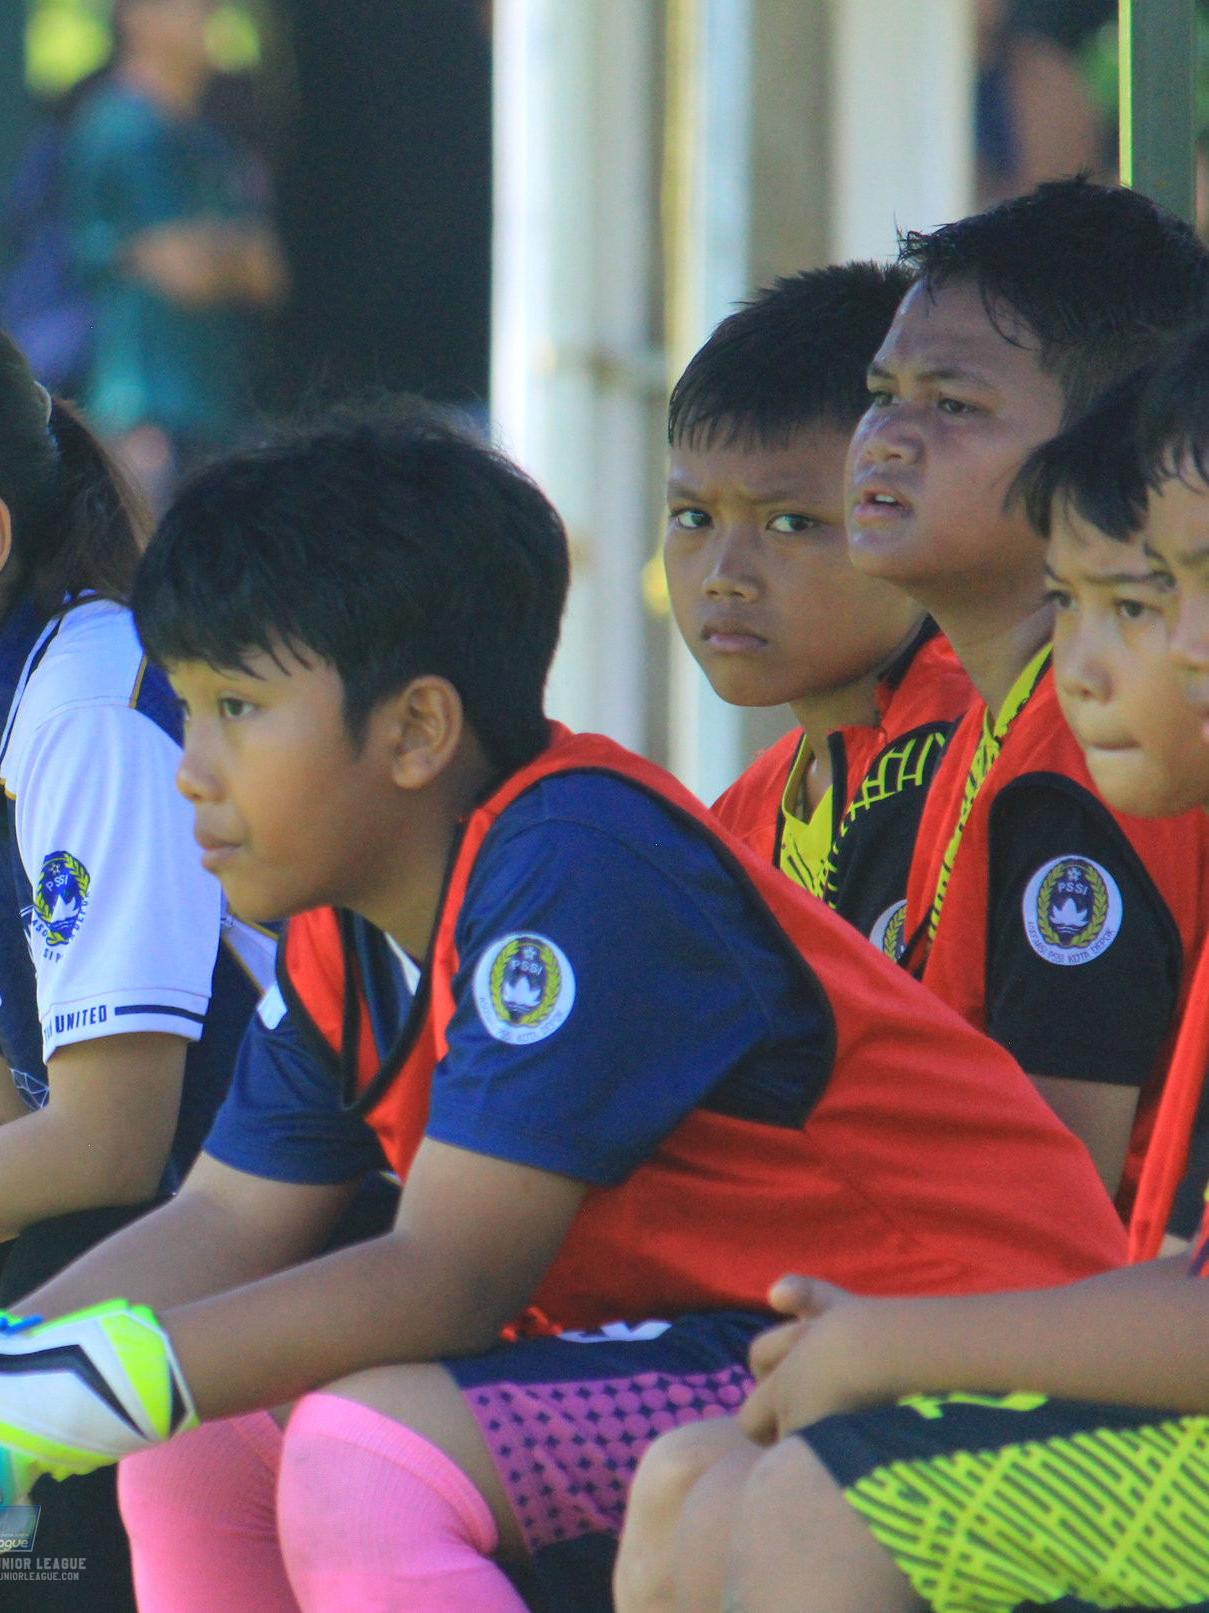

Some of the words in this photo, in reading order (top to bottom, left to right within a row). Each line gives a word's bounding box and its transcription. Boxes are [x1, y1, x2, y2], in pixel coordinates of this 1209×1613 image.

[46, 875, 69, 892] PSSI
[1058, 882, 1089, 895] PSSI
[1068, 951, 1091, 963] KOTA
[510, 959, 544, 975] PSSI
[55, 1004, 107, 1033] UNITED
